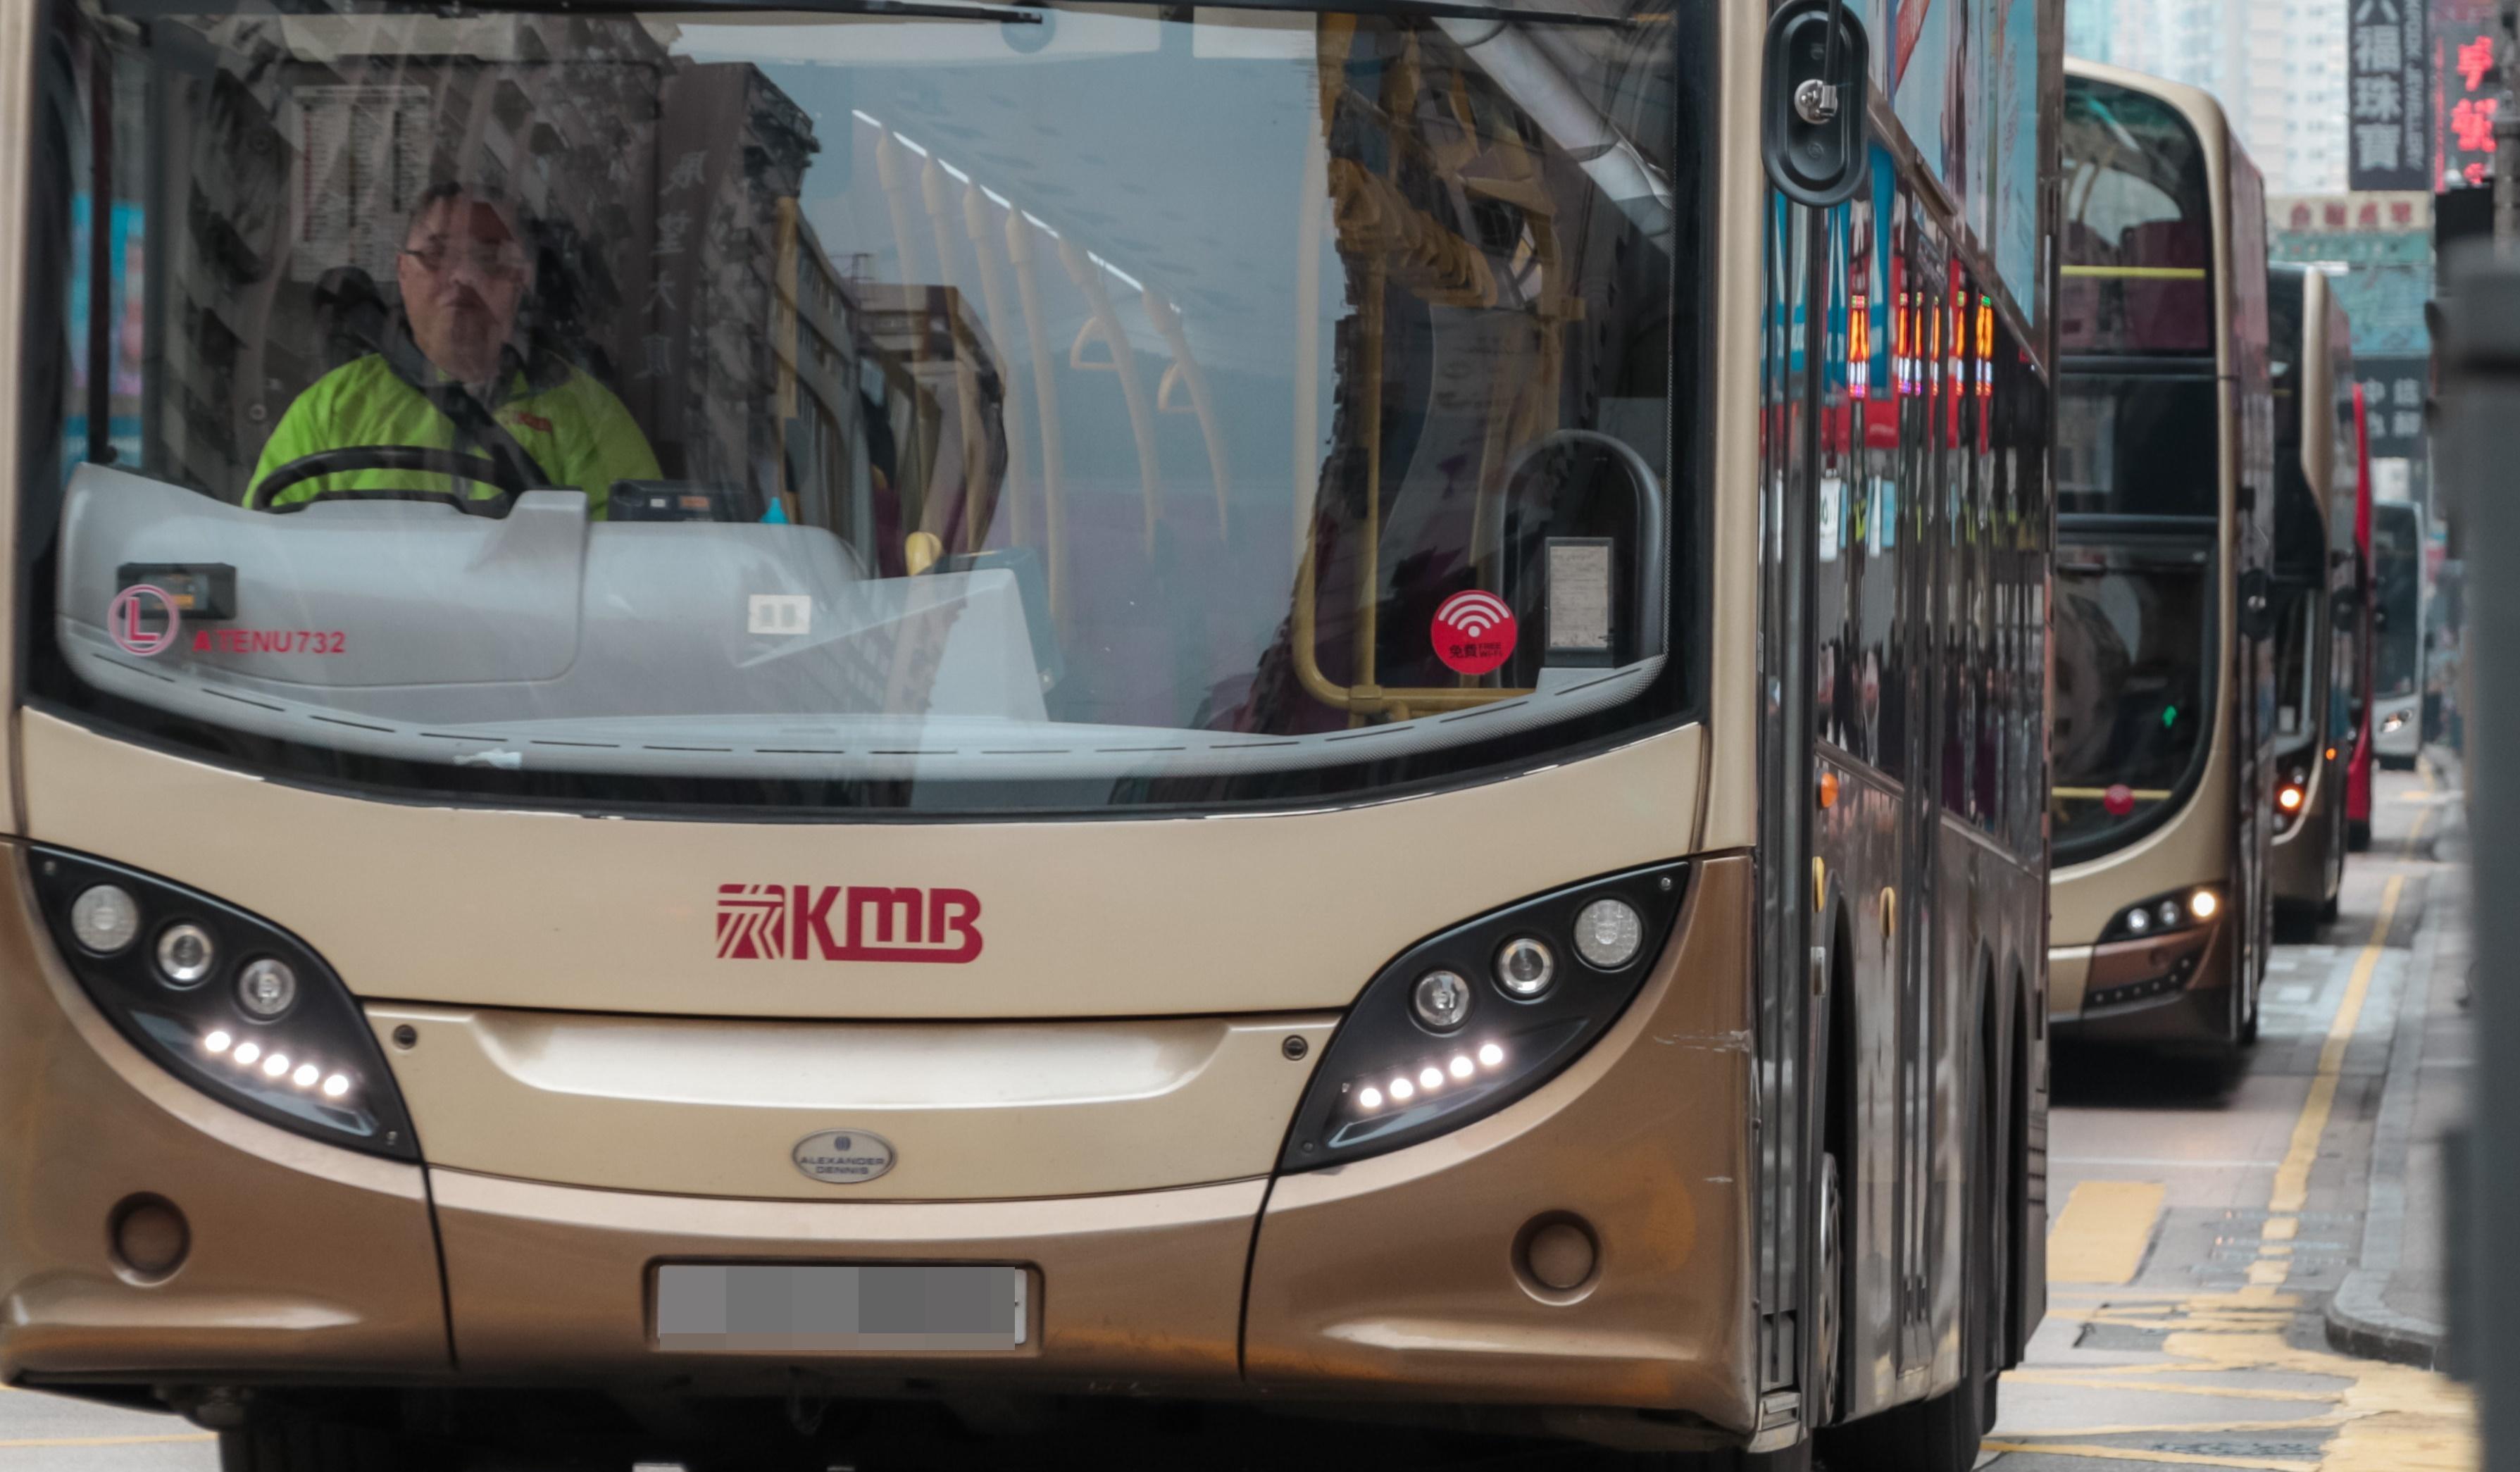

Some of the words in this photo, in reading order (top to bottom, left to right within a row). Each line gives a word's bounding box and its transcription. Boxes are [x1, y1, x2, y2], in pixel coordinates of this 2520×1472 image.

[126, 595, 161, 644] L
[1449, 644, 1478, 659] 免費
[792, 885, 983, 963] KMB
[800, 1156, 885, 1165] ALEXANDER
